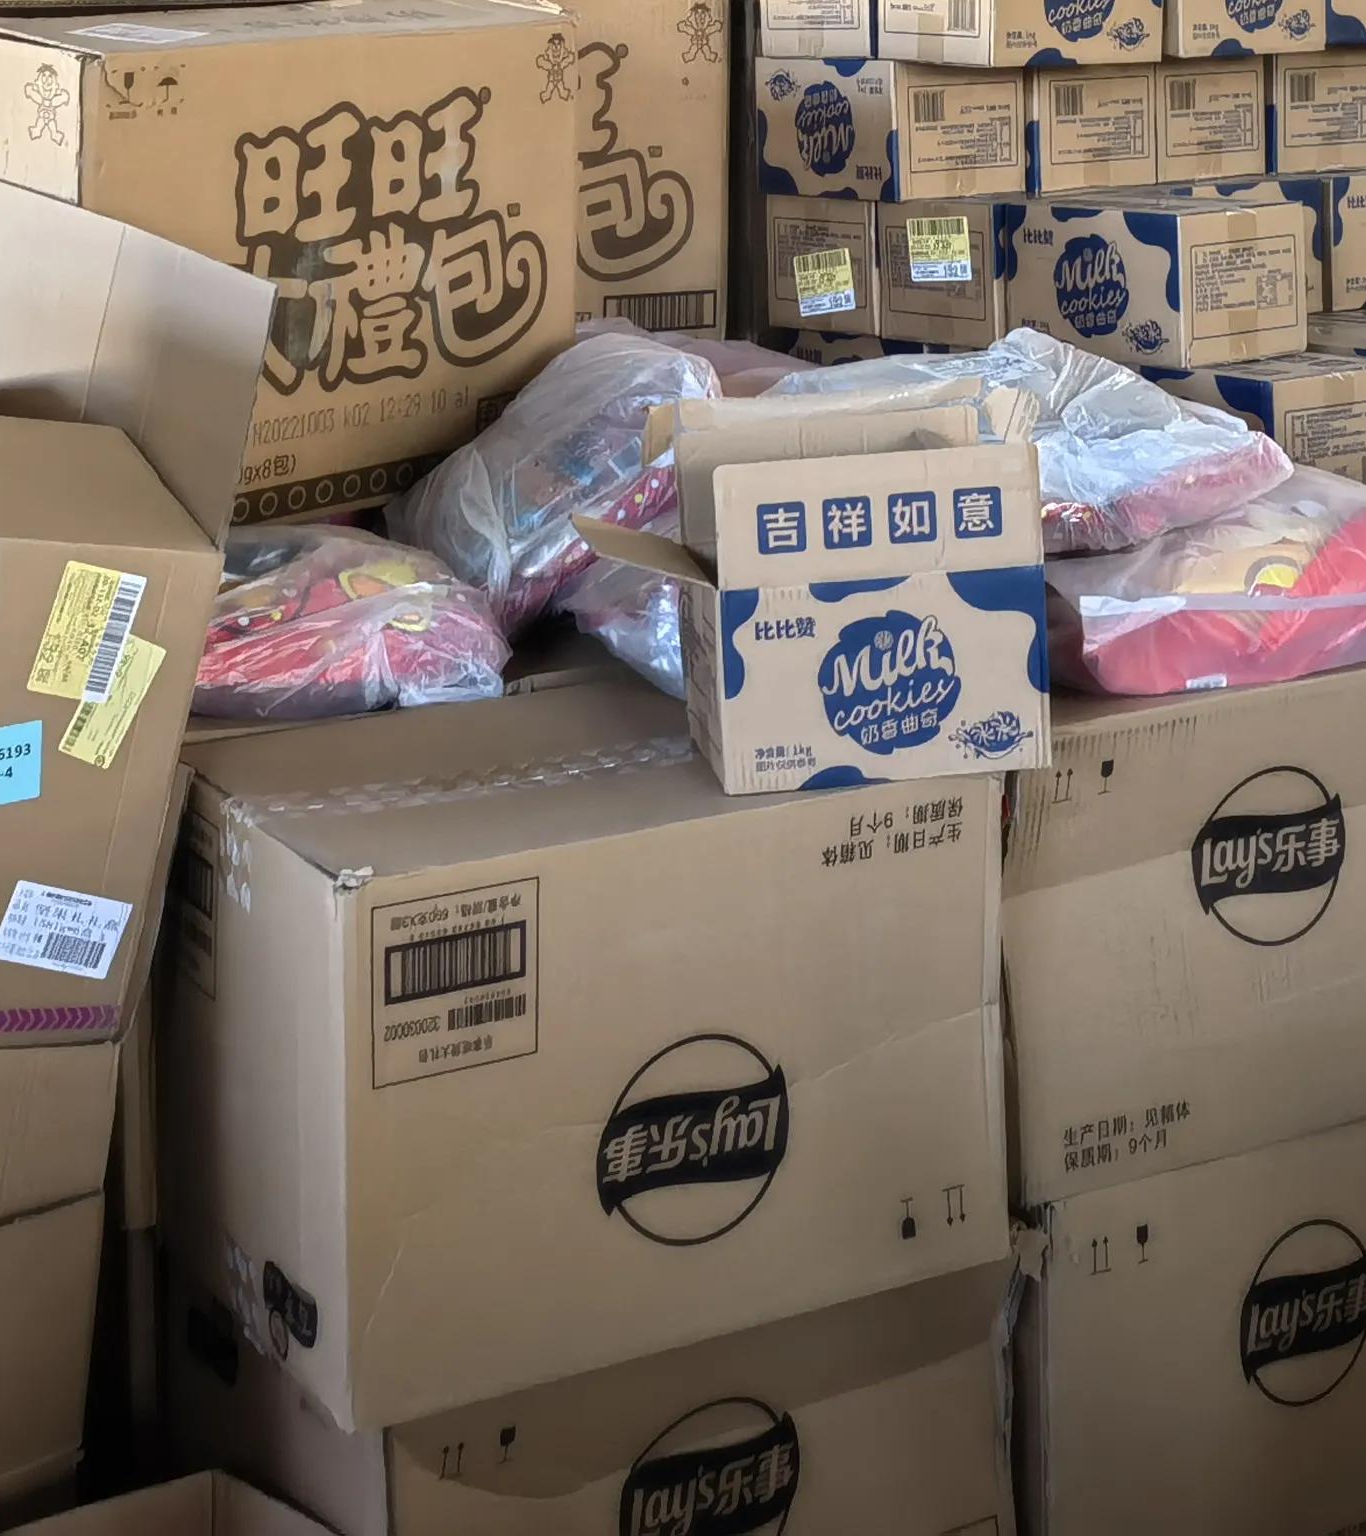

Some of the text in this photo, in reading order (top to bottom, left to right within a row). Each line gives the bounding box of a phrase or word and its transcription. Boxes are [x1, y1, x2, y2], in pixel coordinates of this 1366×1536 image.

[797, 123, 855, 168] Milk
[236, 86, 481, 243] 旺旺
[1055, 240, 1126, 291] Milk
[1060, 287, 1127, 316] cookies
[760, 490, 998, 552] 吉祥如意
[754, 617, 816, 641] 比比赞
[821, 615, 955, 698] Milk
[834, 679, 954, 730] cookies
[861, 708, 938, 745] 奶香曲奇
[849, 810, 893, 837] 9个月
[821, 837, 875, 868] 见箱体
[1145, 1100, 1191, 1128] 见箱体
[1128, 1129, 1168, 1156] 9个月
